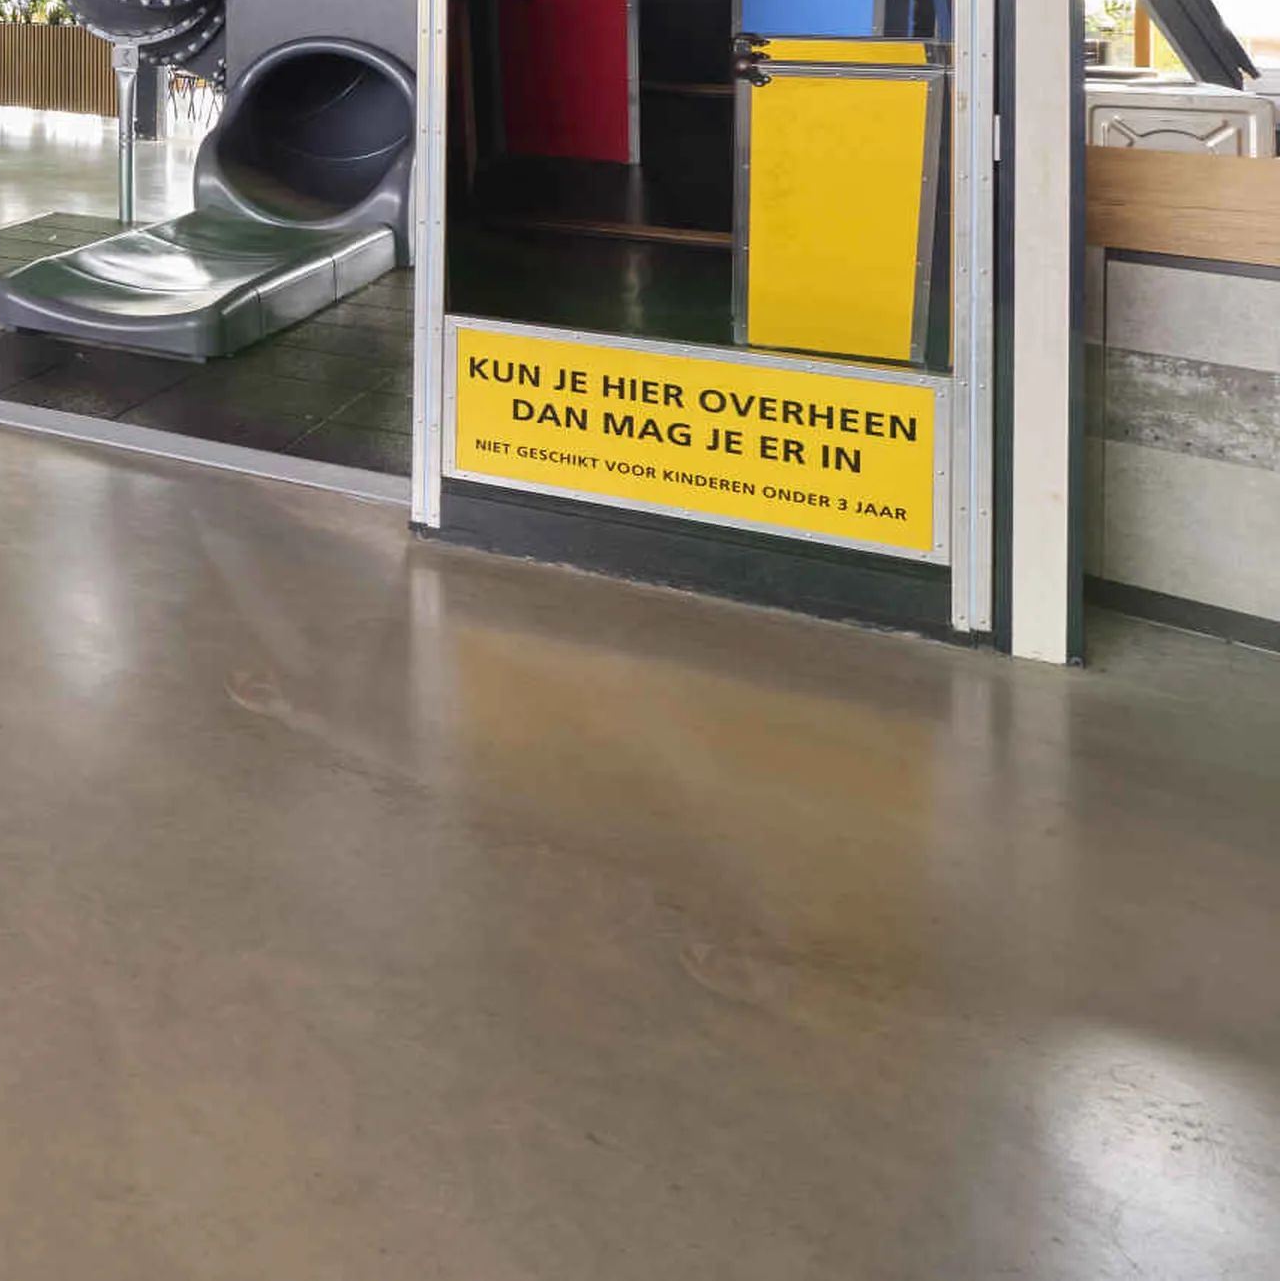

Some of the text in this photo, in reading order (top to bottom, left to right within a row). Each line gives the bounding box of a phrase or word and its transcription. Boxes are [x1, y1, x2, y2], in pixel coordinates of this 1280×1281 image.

[469, 356, 917, 442] KUN JE HIER OVERHEEN
[512, 398, 861, 474] DAN MAG JE ER IN
[475, 438, 908, 521] NIET GESCHIKT VOOR KINDEREN ONDER 3 JAAR
